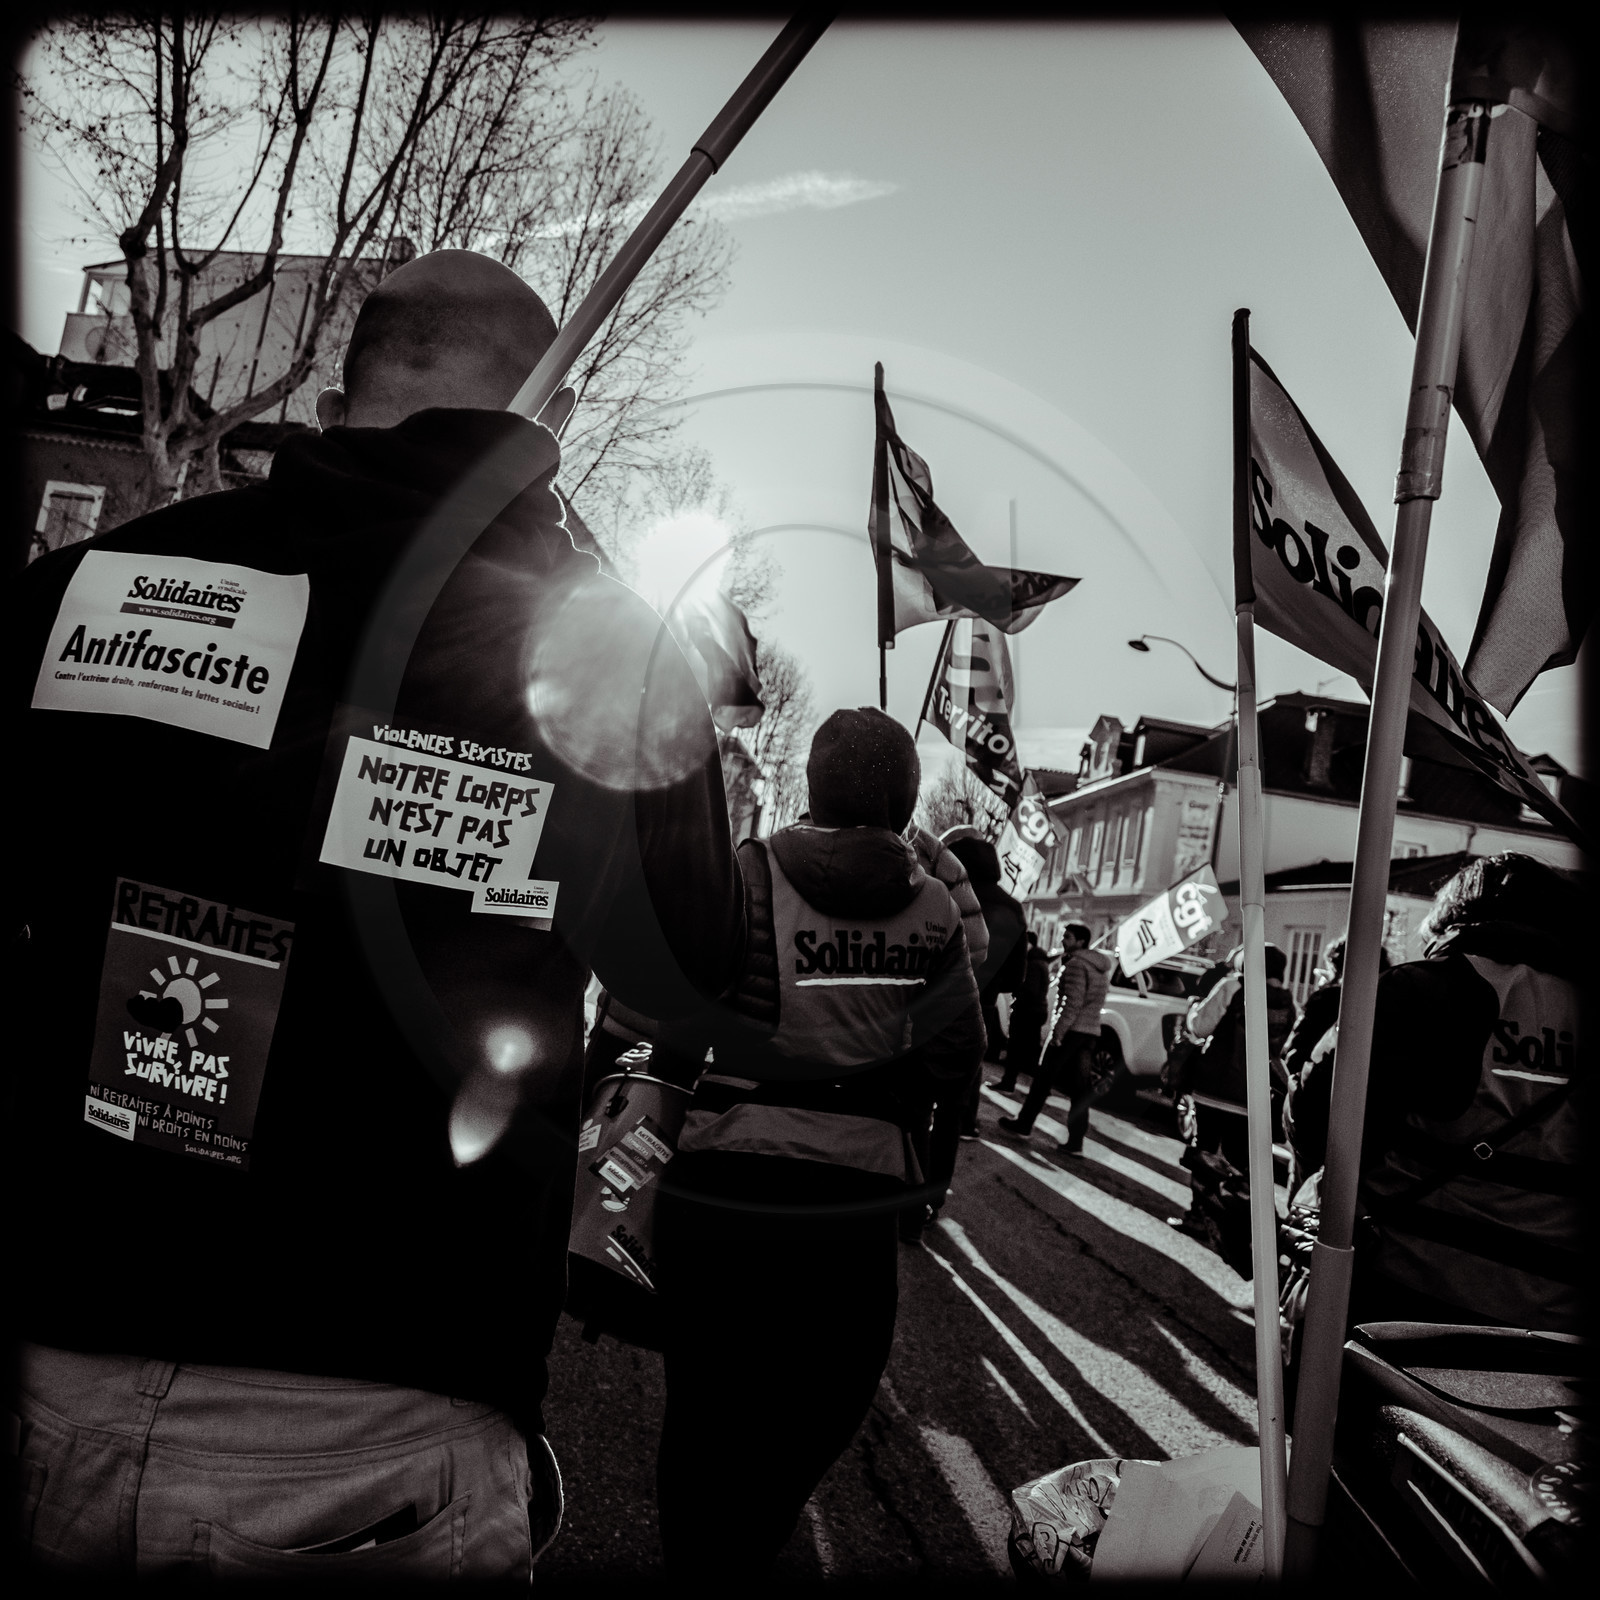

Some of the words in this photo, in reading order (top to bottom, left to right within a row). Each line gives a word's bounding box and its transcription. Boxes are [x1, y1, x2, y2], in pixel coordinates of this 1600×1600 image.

[127, 575, 245, 614] Solidaires
[138, 605, 217, 625] www.solidaires.org
[58, 624, 270, 695] Antifasciste
[54, 670, 76, 681] Contre
[111, 674, 135, 688] droite,
[137, 679, 179, 694] renforçons
[181, 686, 193, 698] les
[195, 688, 220, 704] luttes
[357, 754, 452, 800] NOTRE
[455, 774, 541, 817] CORPS
[368, 796, 453, 837] N'EST
[456, 815, 513, 849] PAS
[363, 838, 407, 867] UN
[412, 847, 503, 883] OBJET
[484, 887, 549, 907] Solidaires
[116, 880, 294, 962] RETRAITES
[189, 1050, 230, 1079] PAS
[88, 1104, 131, 1131] Solidaires
[103, 1088, 160, 1115] RETRAITES
[176, 1108, 214, 1130] POINTS
[138, 1114, 149, 1127] NI
[152, 1119, 190, 1138] DROITS
[195, 1129, 210, 1143] EN
[213, 1133, 249, 1152] MOINS
